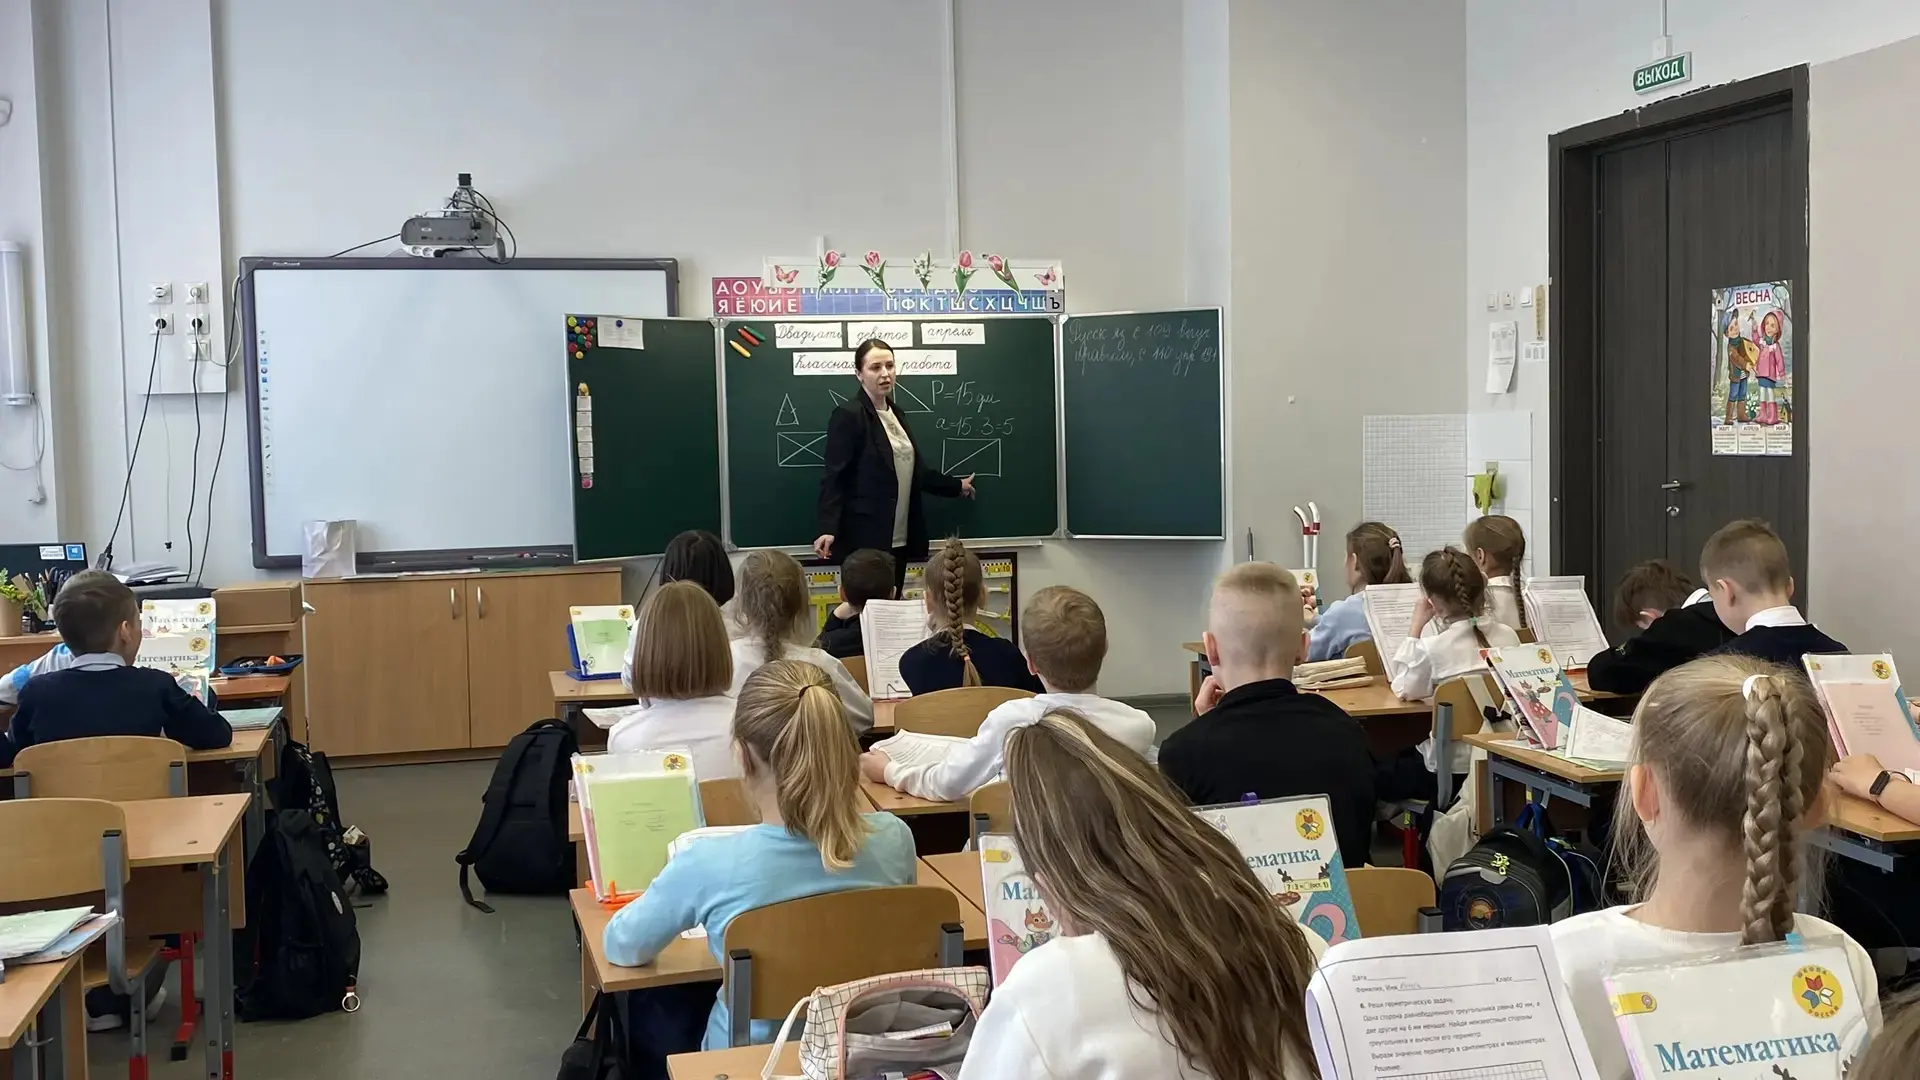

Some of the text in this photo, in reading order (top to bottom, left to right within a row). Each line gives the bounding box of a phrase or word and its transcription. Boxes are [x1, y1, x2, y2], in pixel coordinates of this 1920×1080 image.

[1637, 60, 1680, 87] ВЫХОД
[1735, 289, 1771, 304] ВЕСНА
[776, 325, 843, 344] Двадцать
[927, 327, 974, 342] апреля
[900, 354, 952, 375] работа
[1246, 848, 1321, 869] ематика
[1654, 1033, 1842, 1073] Математика
